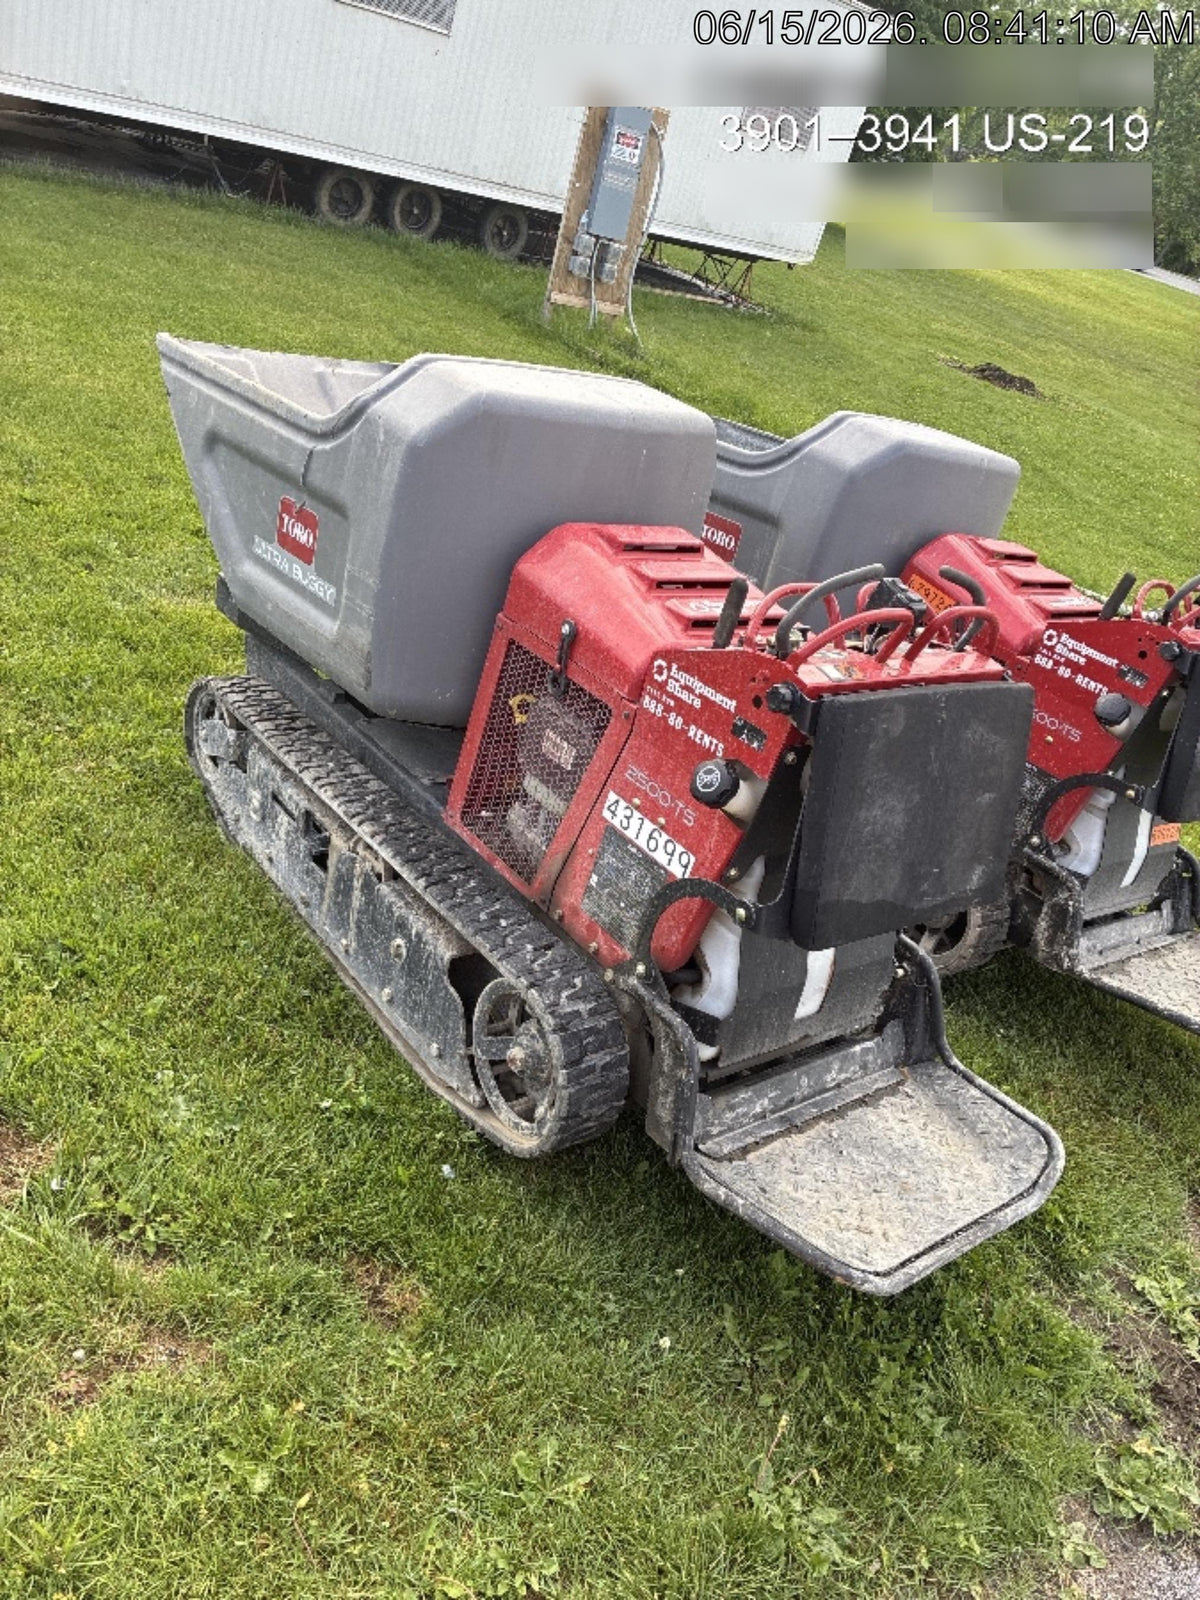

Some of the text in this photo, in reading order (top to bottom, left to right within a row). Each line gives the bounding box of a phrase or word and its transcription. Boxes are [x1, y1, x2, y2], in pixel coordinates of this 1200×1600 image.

[281, 513, 314, 550] TORO
[701, 524, 735, 551] TORO
[1054, 643, 1087, 666] Share
[1060, 632, 1119, 669] Equipment
[669, 662, 738, 713] Equipment
[1034, 653, 1109, 696] 888-80-RENTS
[666, 678, 702, 710] Share
[642, 695, 725, 758] 888-80-RENTS
[606, 798, 692, 879] 431699
